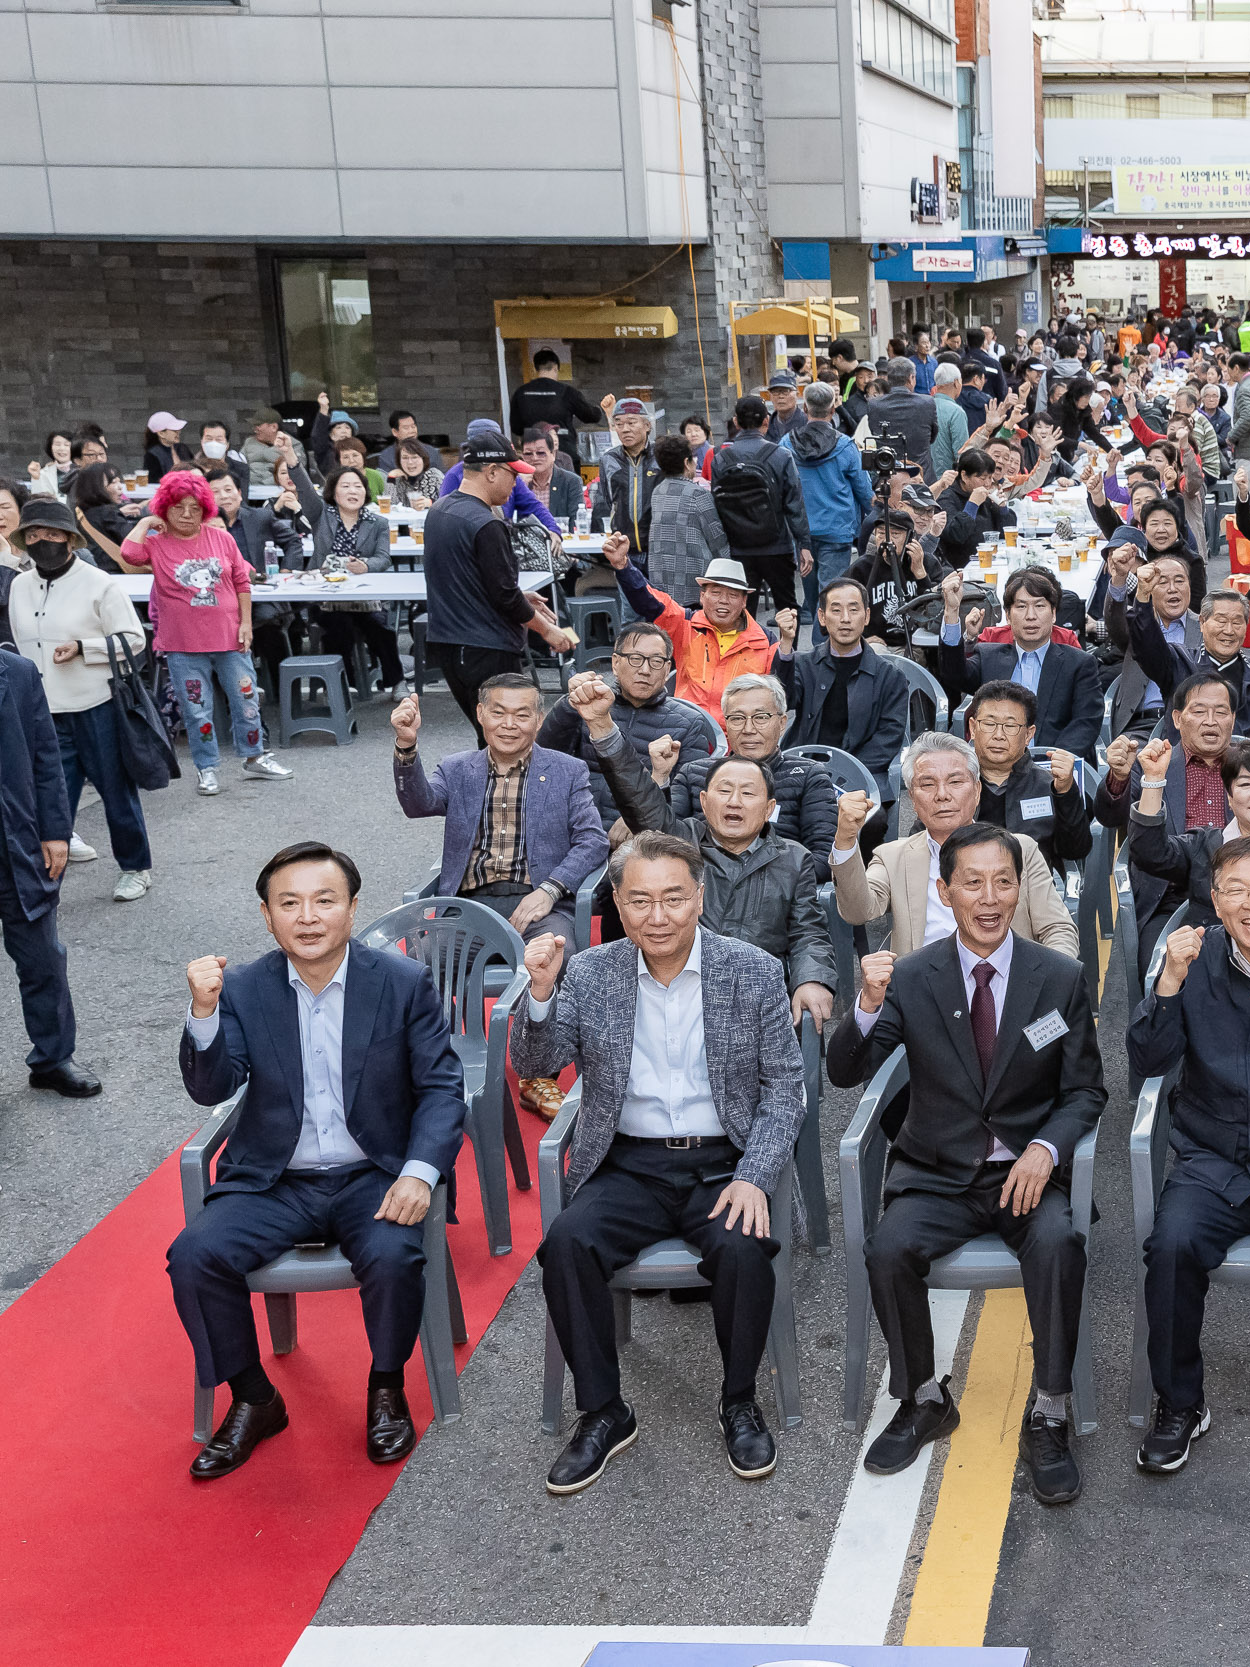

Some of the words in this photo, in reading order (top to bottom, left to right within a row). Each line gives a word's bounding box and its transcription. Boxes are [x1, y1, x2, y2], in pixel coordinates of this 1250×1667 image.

[1120, 156, 1182, 167] 02-466-5003
[1180, 170, 1230, 182] 시장에서도
[1180, 184, 1229, 197] 장바구니를
[872, 582, 886, 605] LET
[887, 581, 896, 598] IT
